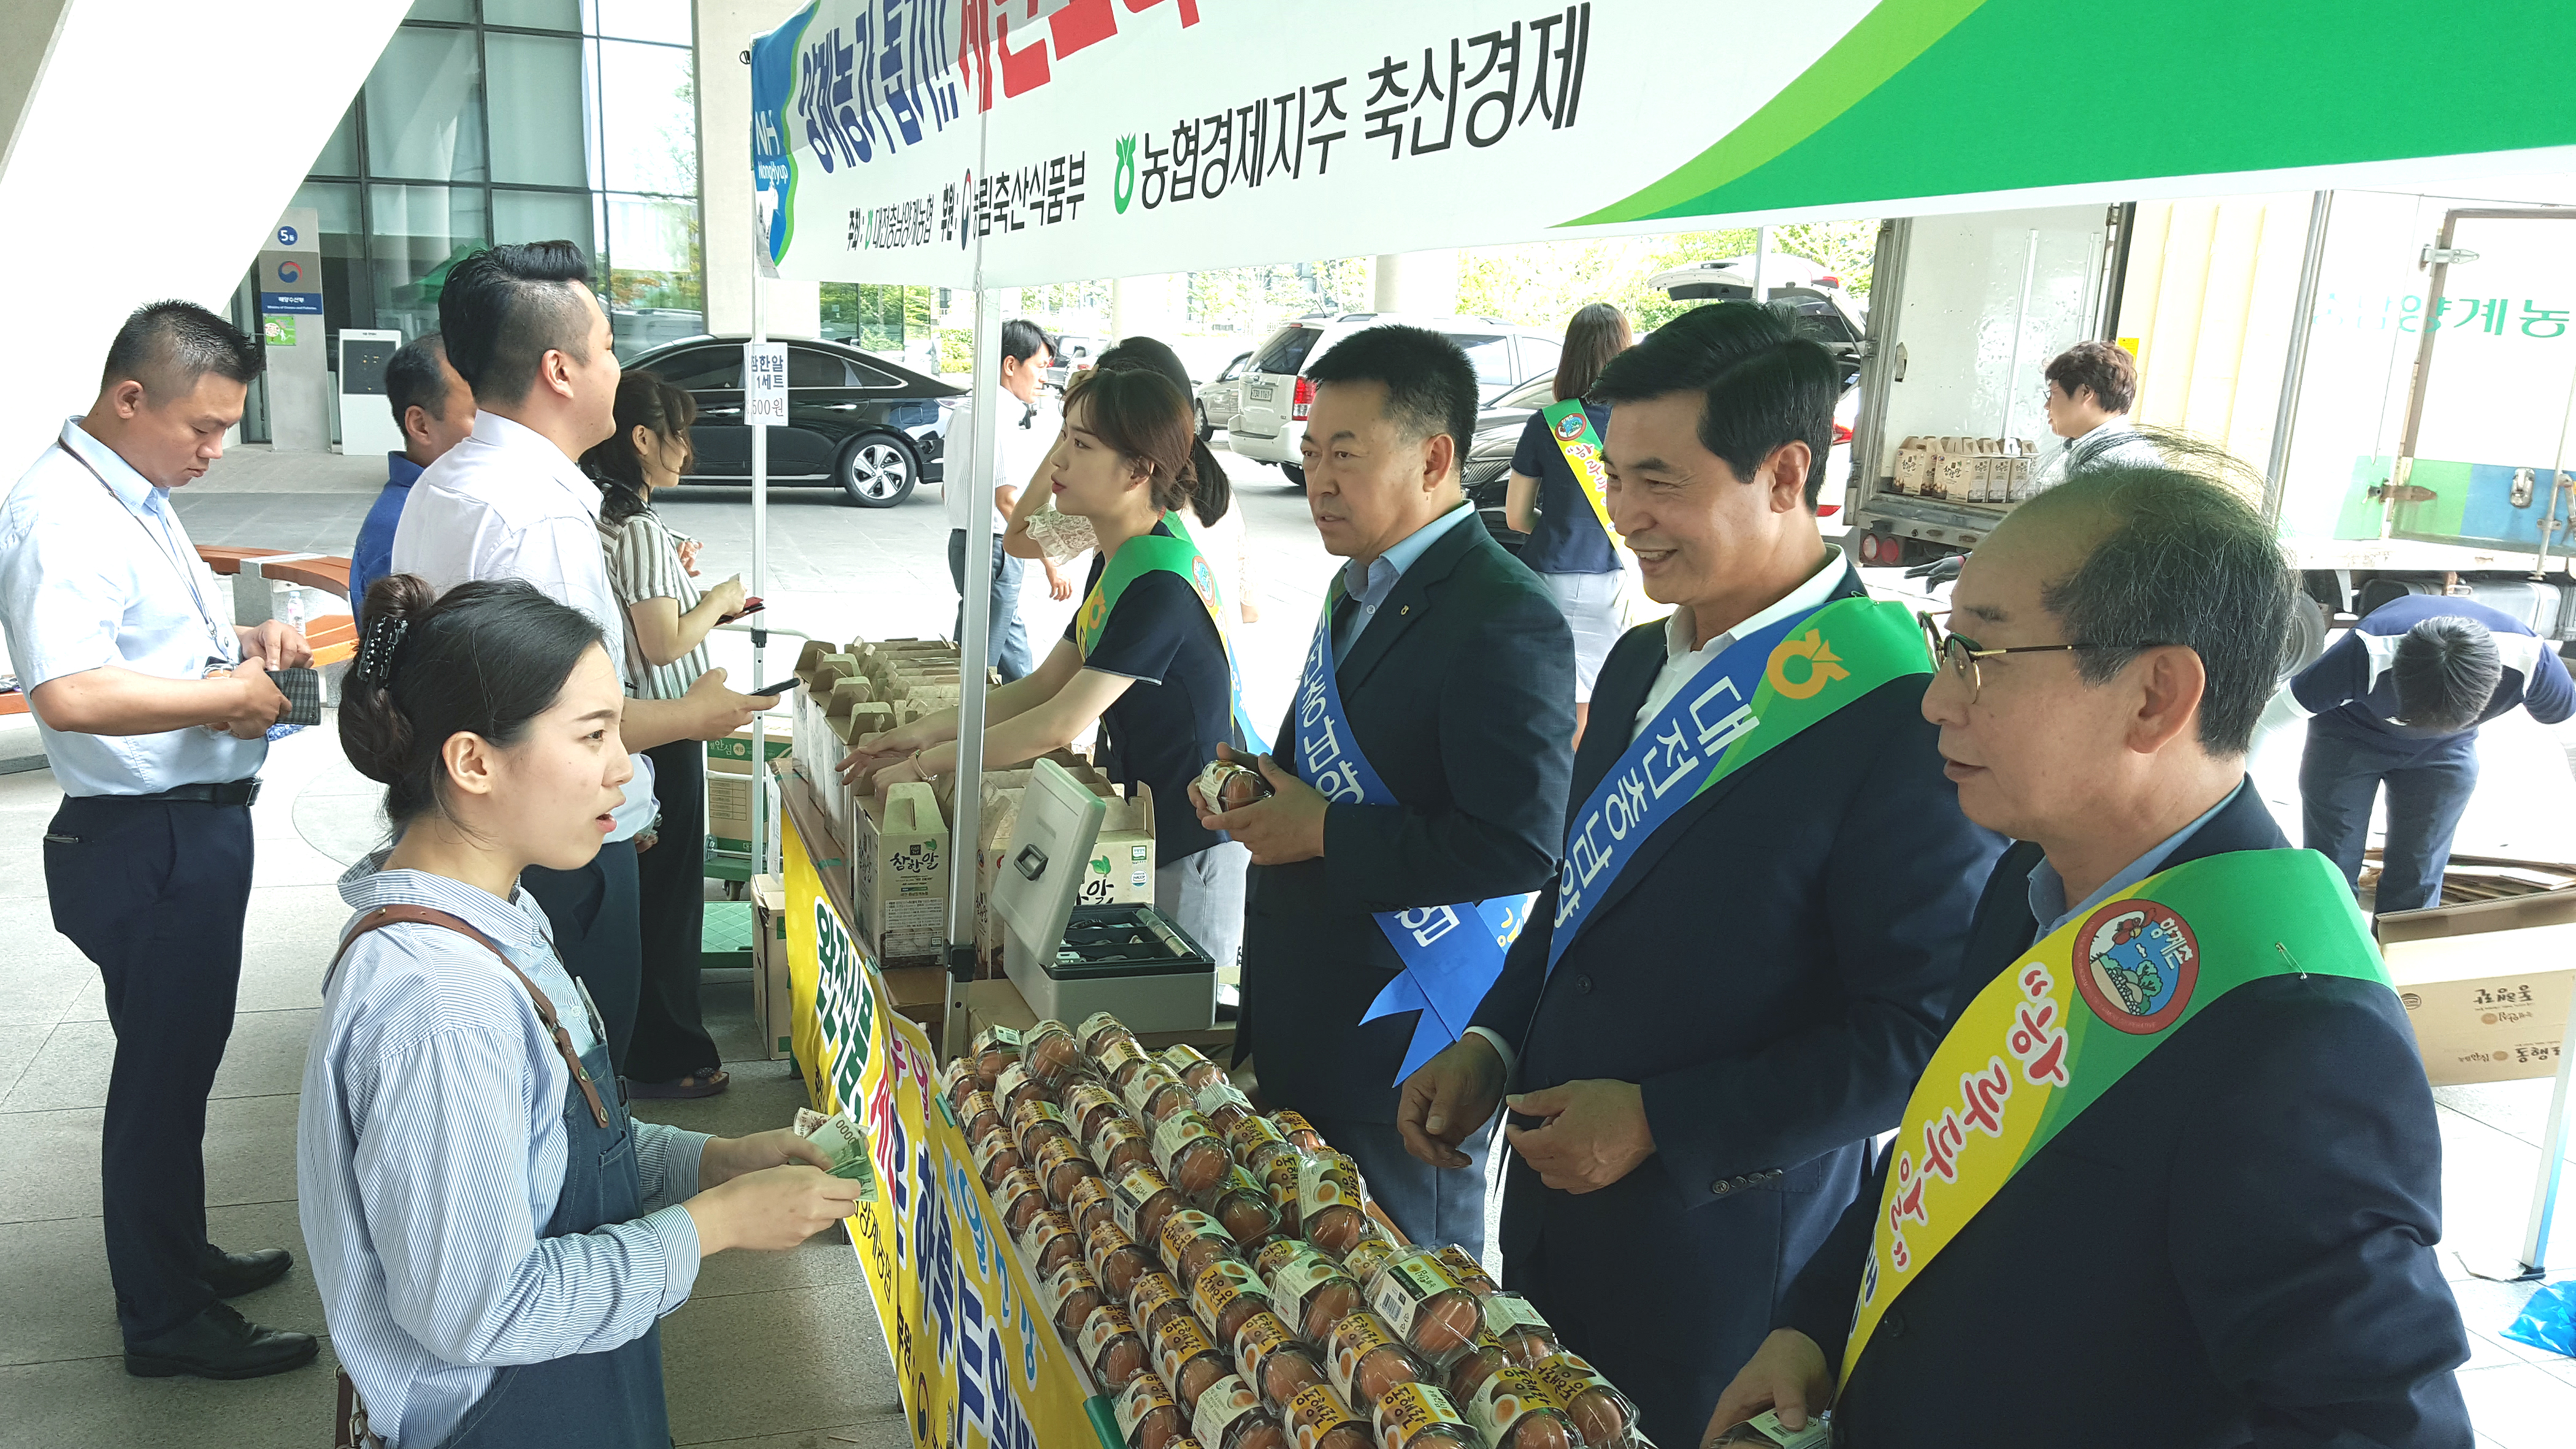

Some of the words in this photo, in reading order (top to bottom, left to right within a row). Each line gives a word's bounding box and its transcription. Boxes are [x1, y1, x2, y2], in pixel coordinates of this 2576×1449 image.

[1141, 76, 1347, 210] 농협경제지주
[1364, 2, 1591, 161] 축산경제
[755, 110, 780, 156] NH
[757, 161, 789, 185] NongHyup
[872, 194, 934, 249] 대전충남양계농협
[973, 150, 1085, 240] 농림축산식품부
[890, 852, 938, 873] 참한알
[2157, 917, 2194, 971] 양계촌
[1165, 1319, 1202, 1355] 동행란
[1246, 1314, 1284, 1352] 동행란
[1340, 1314, 1378, 1351] 동행란
[1504, 1369, 1552, 1405] 동행란
[1538, 1360, 1584, 1402] 동행란
[1297, 1388, 1340, 1430] 동행란
[1384, 1386, 1428, 1431] 동행란
